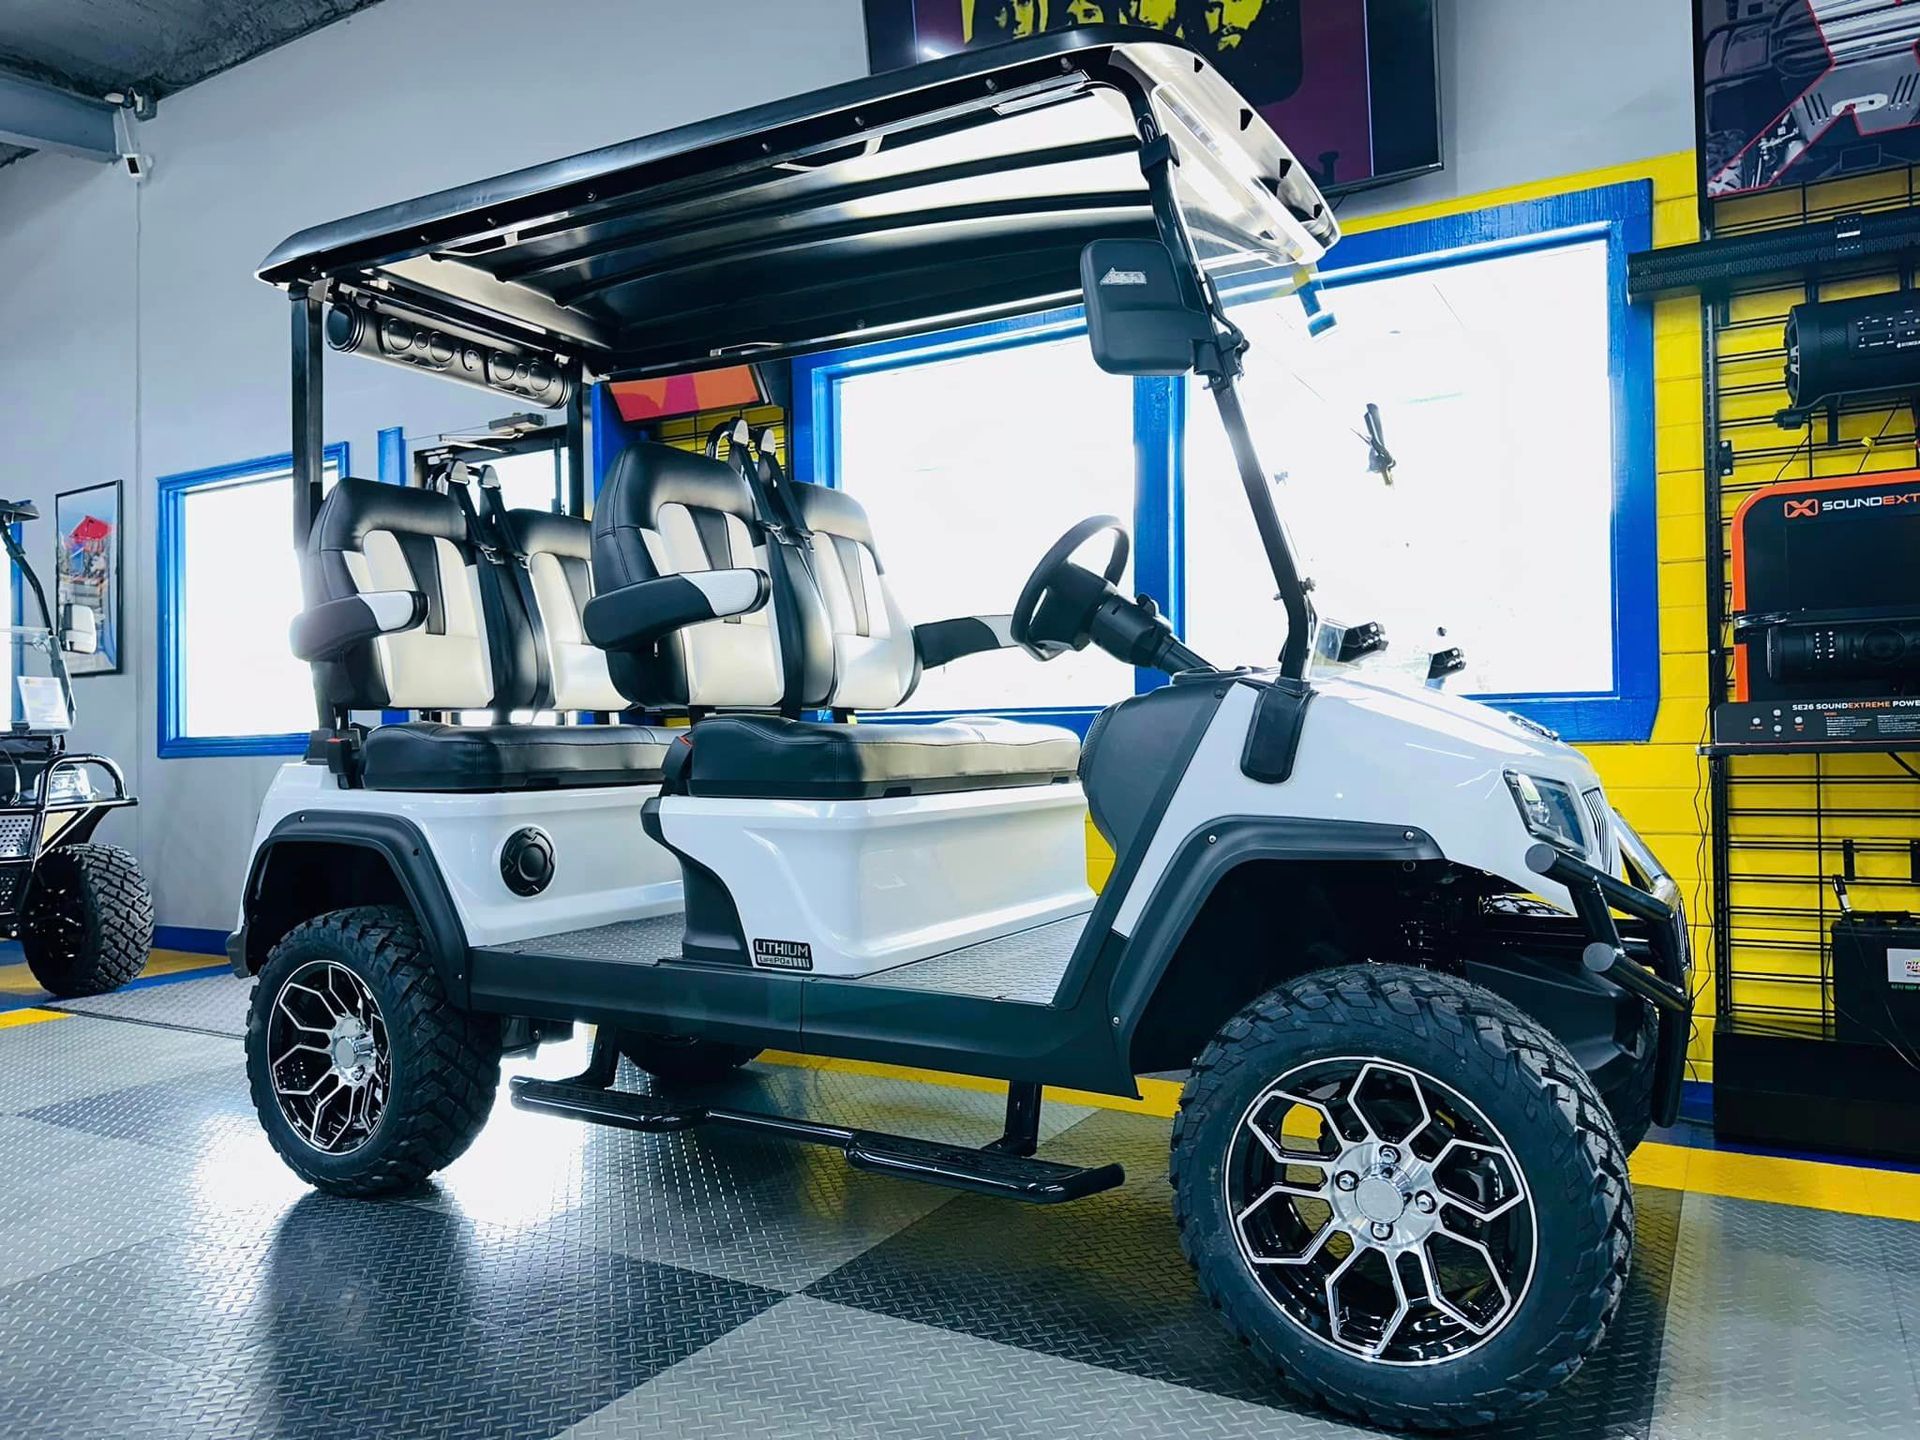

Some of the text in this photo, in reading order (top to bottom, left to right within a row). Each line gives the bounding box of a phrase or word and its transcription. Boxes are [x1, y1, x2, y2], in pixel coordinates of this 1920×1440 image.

[1822, 493, 1920, 510] SOUNDEXT
[1816, 701, 1890, 710] SOUNDEXTREME
[755, 940, 808, 957] LITHIUM
